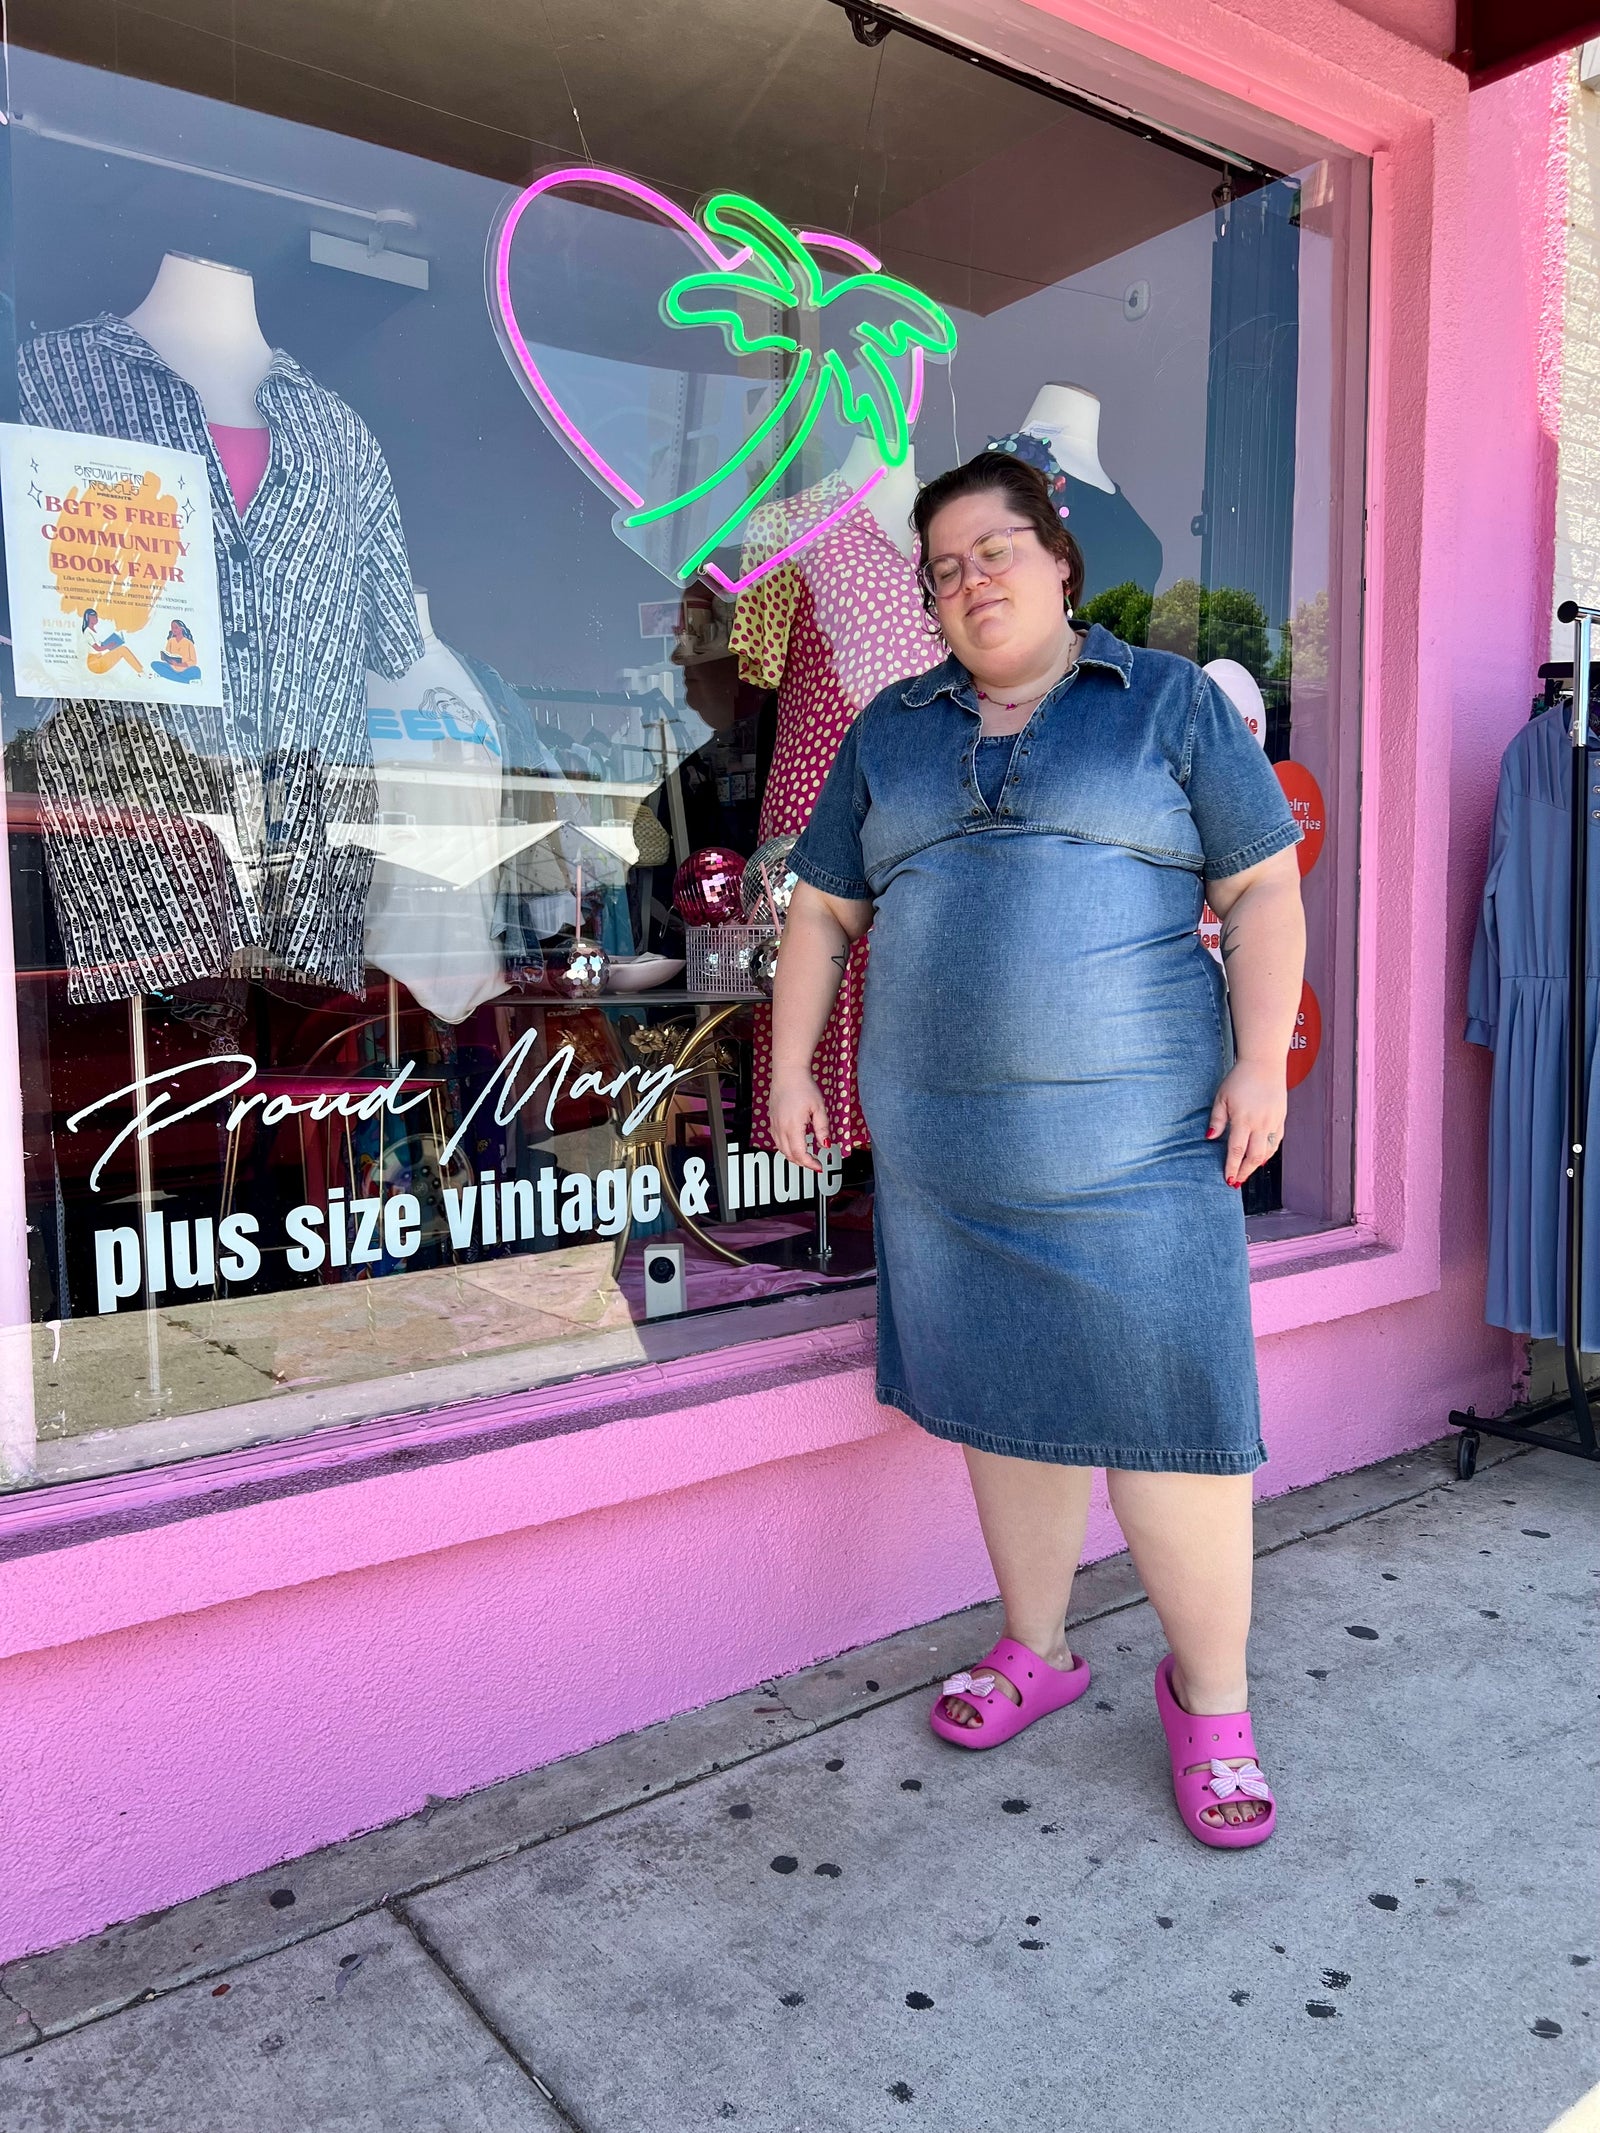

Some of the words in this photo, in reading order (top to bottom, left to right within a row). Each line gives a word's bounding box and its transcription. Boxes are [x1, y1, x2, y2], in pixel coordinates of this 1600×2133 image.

[74, 465, 118, 481] BROWN
[121, 473, 148, 486] GIRL
[45, 495, 117, 520] BGT'S
[125, 507, 185, 529] FREE
[41, 524, 190, 556] COMMUNITY
[51, 552, 121, 575] BOOK
[128, 561, 185, 582] FAIR
[66, 1054, 432, 1193] Proud
[439, 1028, 694, 1166] Mary
[94, 1210, 261, 1314] plus
[285, 1187, 422, 1272] size
[442, 1164, 661, 1250] vintage
[680, 1156, 710, 1217] &
